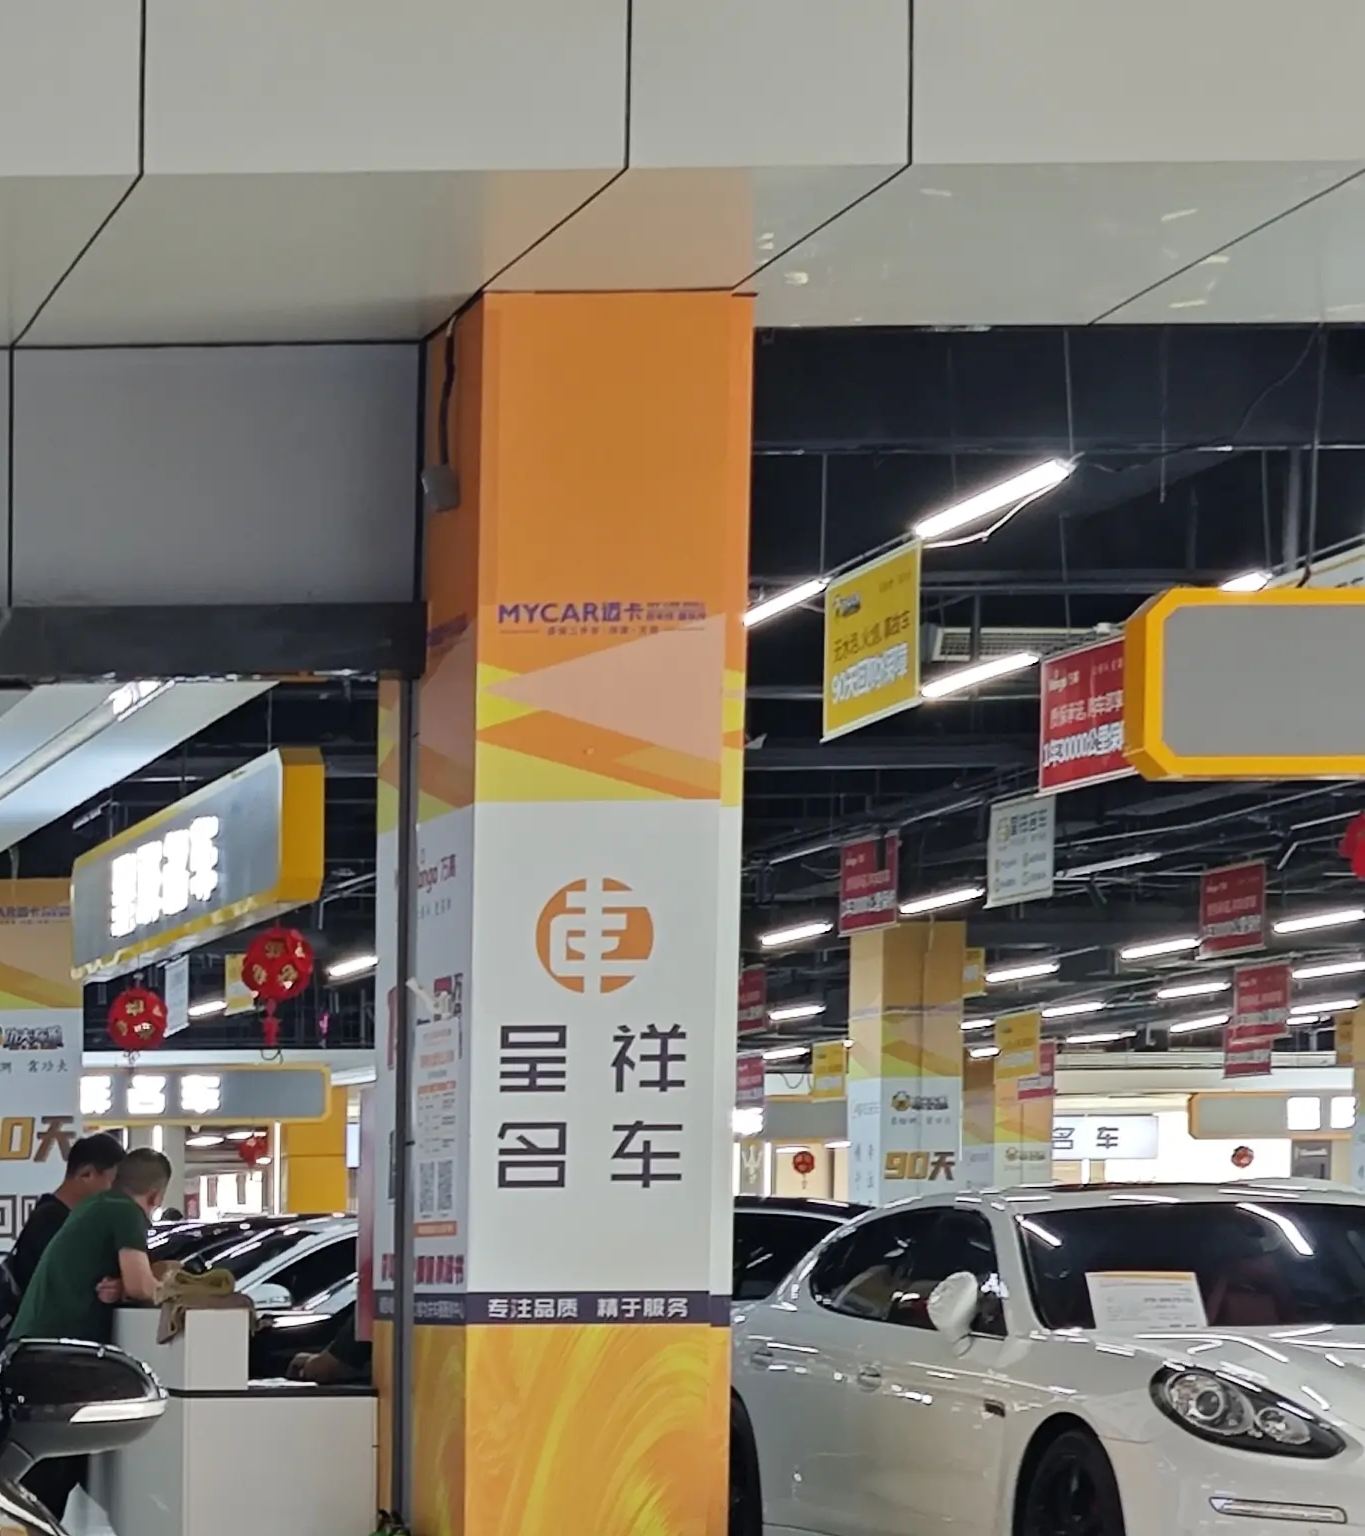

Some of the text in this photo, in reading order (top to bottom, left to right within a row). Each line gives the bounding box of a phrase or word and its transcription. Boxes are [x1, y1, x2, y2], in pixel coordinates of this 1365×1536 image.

[498, 1024, 688, 1093] 呈祥
[497, 1119, 684, 1189] 名车
[883, 1151, 956, 1181] 90天
[487, 1298, 578, 1319] 专注品质
[597, 1297, 689, 1319] 精于服务
